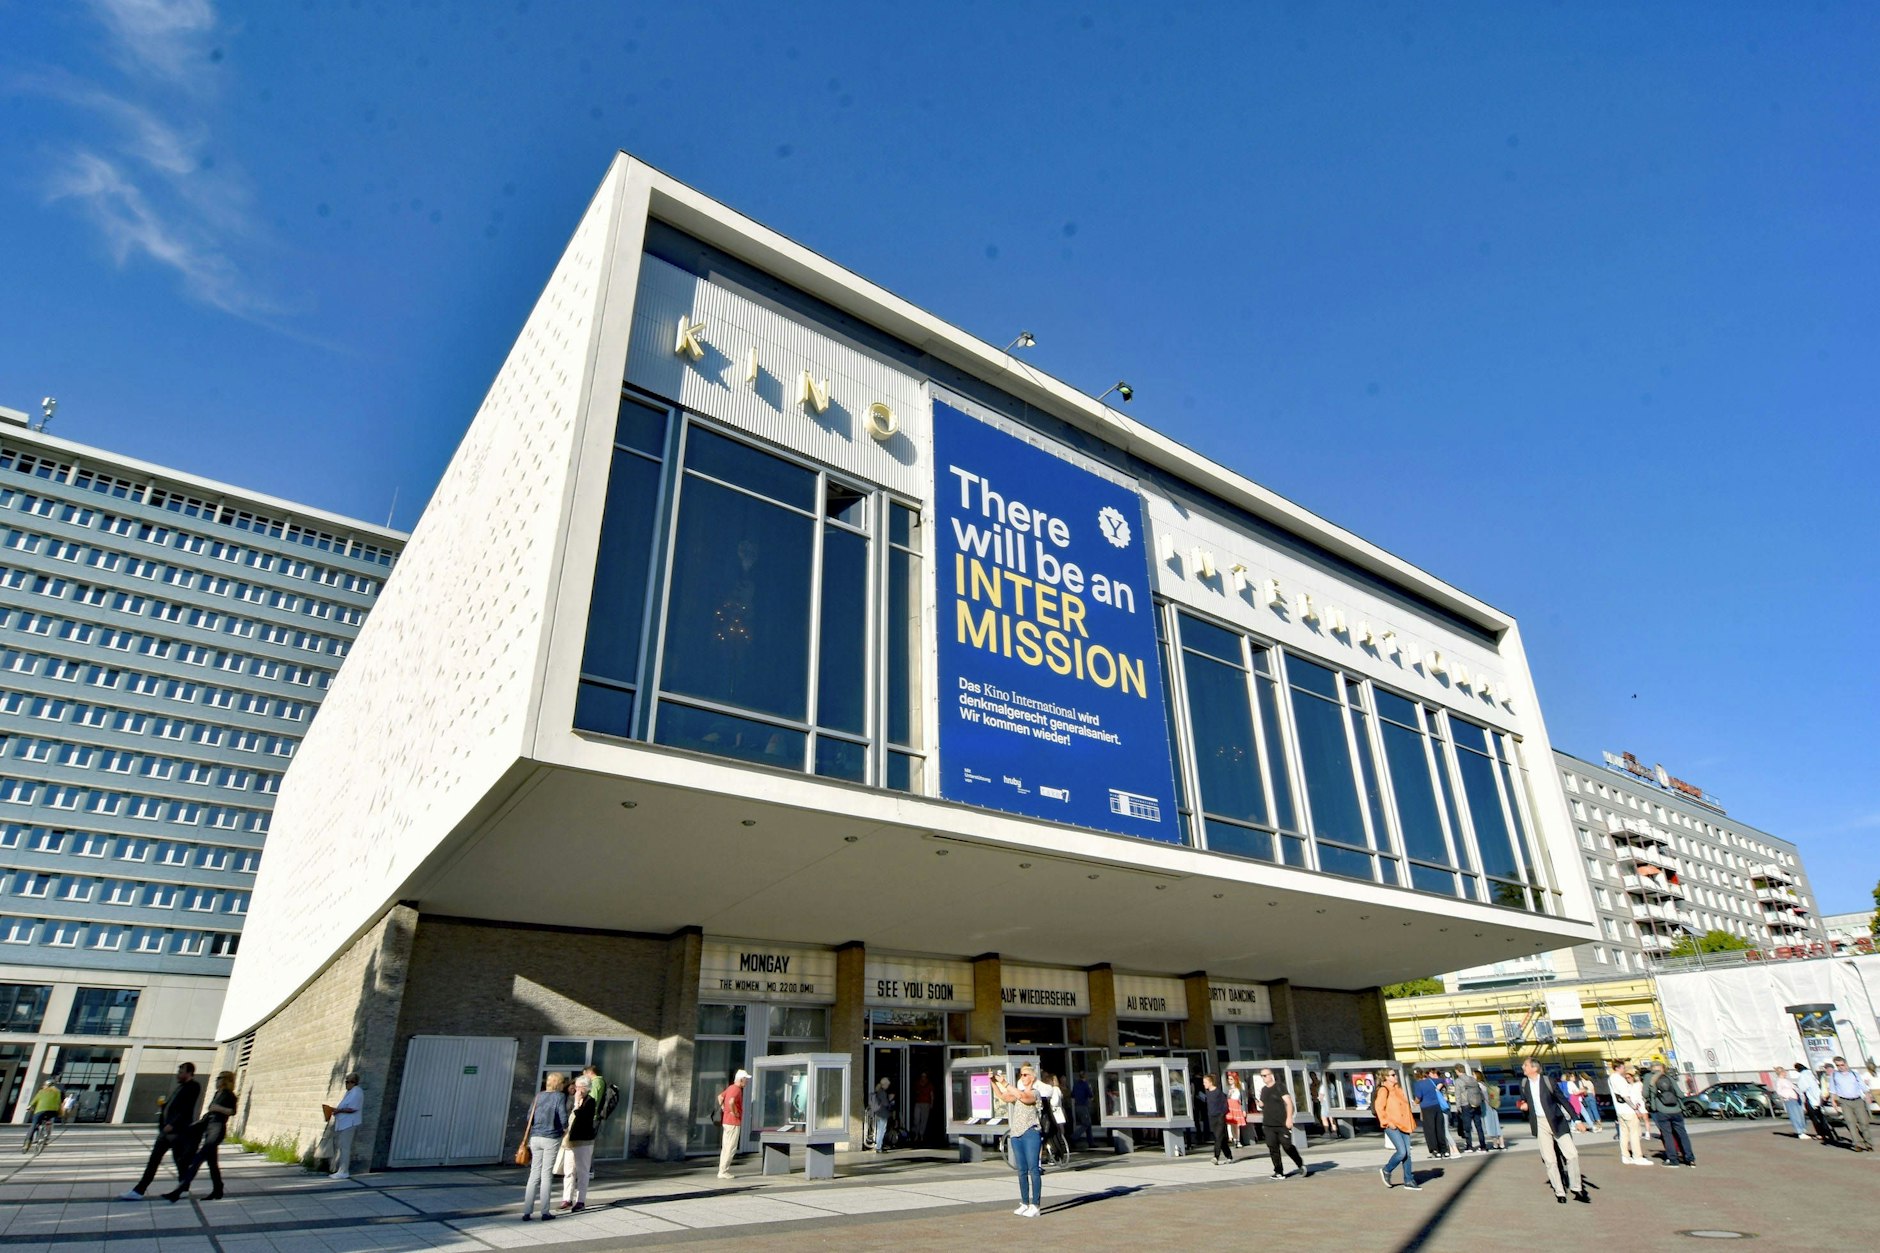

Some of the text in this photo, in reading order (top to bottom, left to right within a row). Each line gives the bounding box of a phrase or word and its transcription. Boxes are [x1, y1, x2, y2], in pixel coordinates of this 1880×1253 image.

[675, 314, 899, 440] KINO
[950, 464, 1071, 548] There
[951, 517, 1135, 614] will be an
[956, 553, 1089, 638] INTER
[1160, 533, 1512, 704] INTERNATIONAL
[957, 599, 1147, 699] MISSION
[958, 676, 1100, 726] Das Kino International wird
[959, 693, 1122, 745] denkmalgerecht generalsaniert.
[959, 706, 1071, 746] Wir kommen wieder!
[720, 980, 732, 990] THE
[735, 980, 760, 991] WOMEN
[740, 953, 790, 974] MONGAY
[877, 980, 954, 1001] SEE YOU SOON
[1001, 988, 1076, 1006] AUF WIEDERSEHEN
[1127, 995, 1166, 1012] AU REVOIR
[1229, 988, 1256, 1003] DANCING
